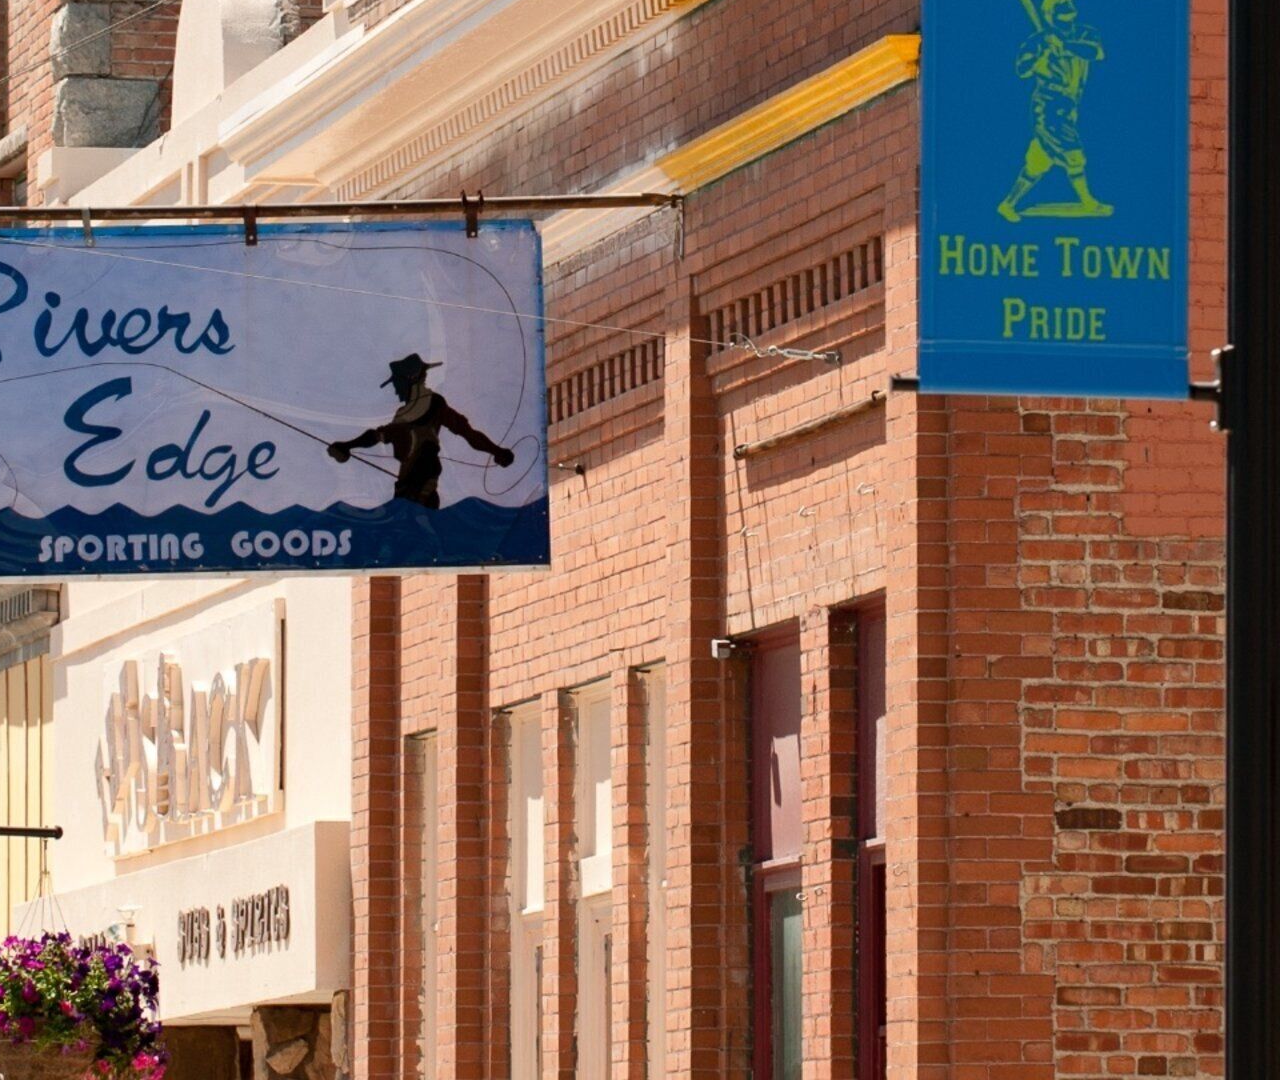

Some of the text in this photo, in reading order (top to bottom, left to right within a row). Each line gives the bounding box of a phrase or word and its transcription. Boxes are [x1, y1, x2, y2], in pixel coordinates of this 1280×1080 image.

[62, 375, 280, 508] Edge
[38, 528, 352, 563] SPORTING GOODS
